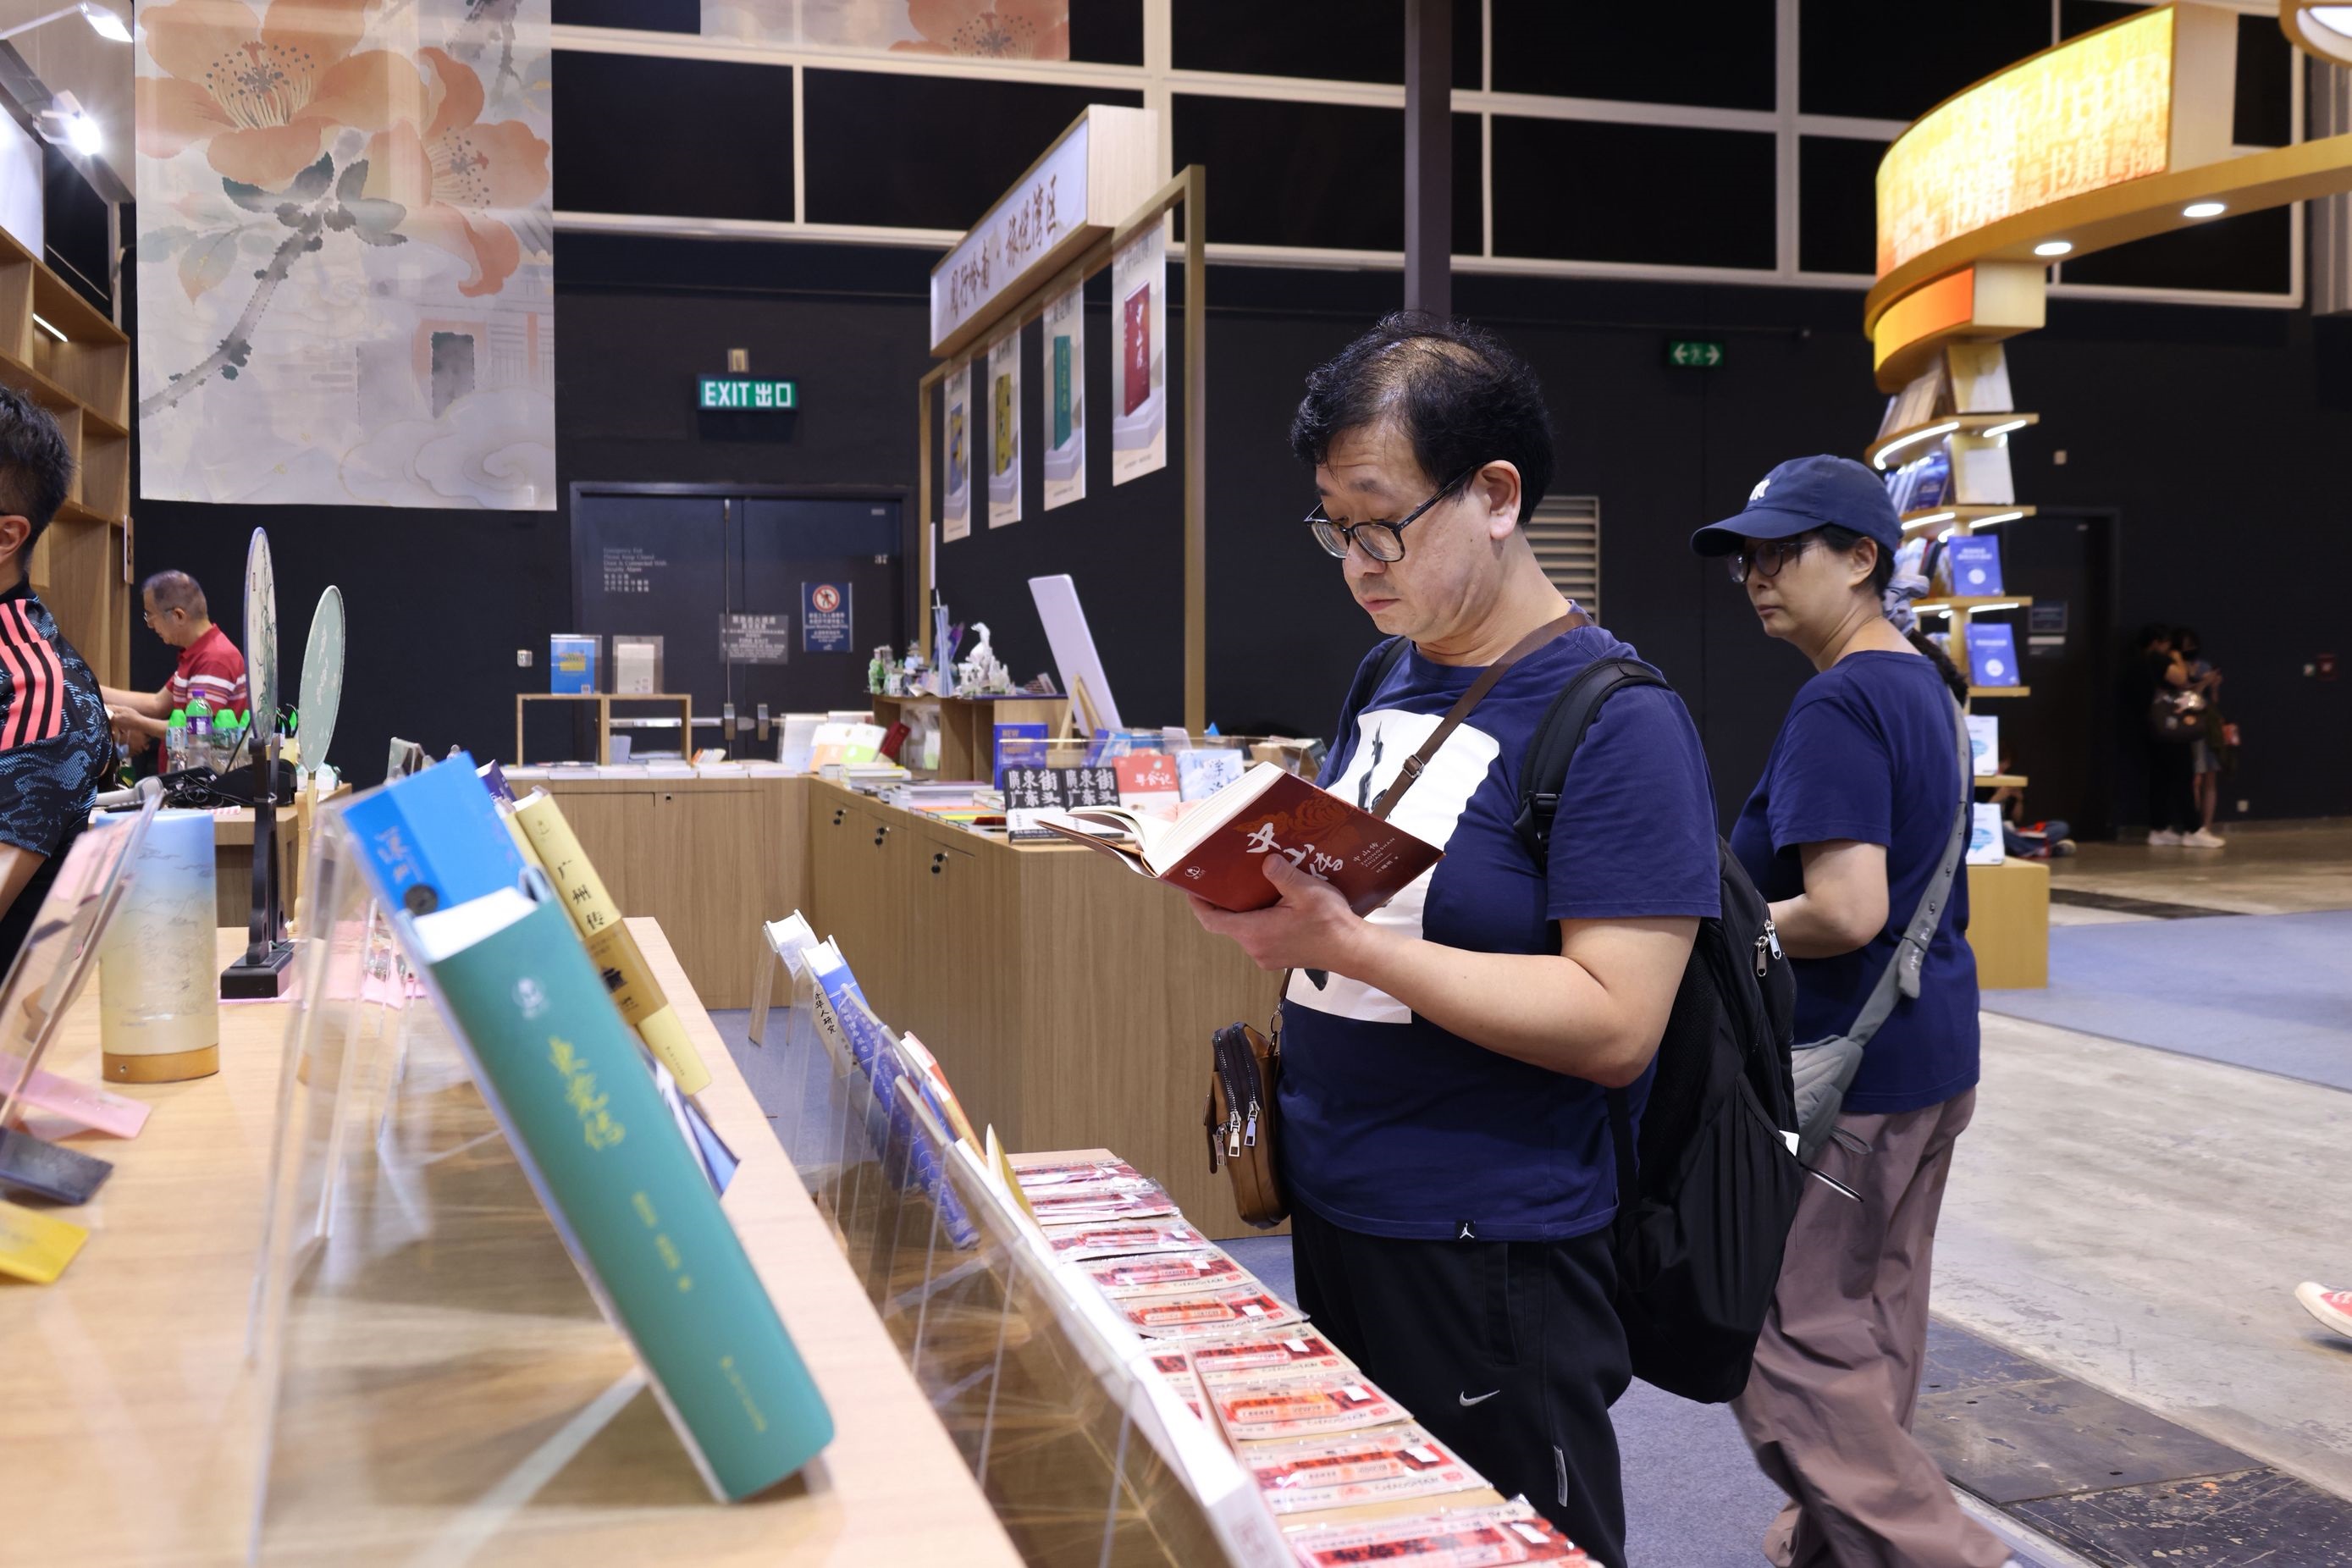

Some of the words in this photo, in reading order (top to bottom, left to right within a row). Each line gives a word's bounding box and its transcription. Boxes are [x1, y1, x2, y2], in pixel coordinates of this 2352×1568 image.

[704, 381, 750, 406] EXIT
[754, 382, 792, 406] 出口
[1353, 842, 1378, 862] 中山传
[1361, 836, 1395, 865] ZHONGSHAN
[1365, 853, 1383, 868] ZHUAN
[557, 859, 605, 930] 广州传
